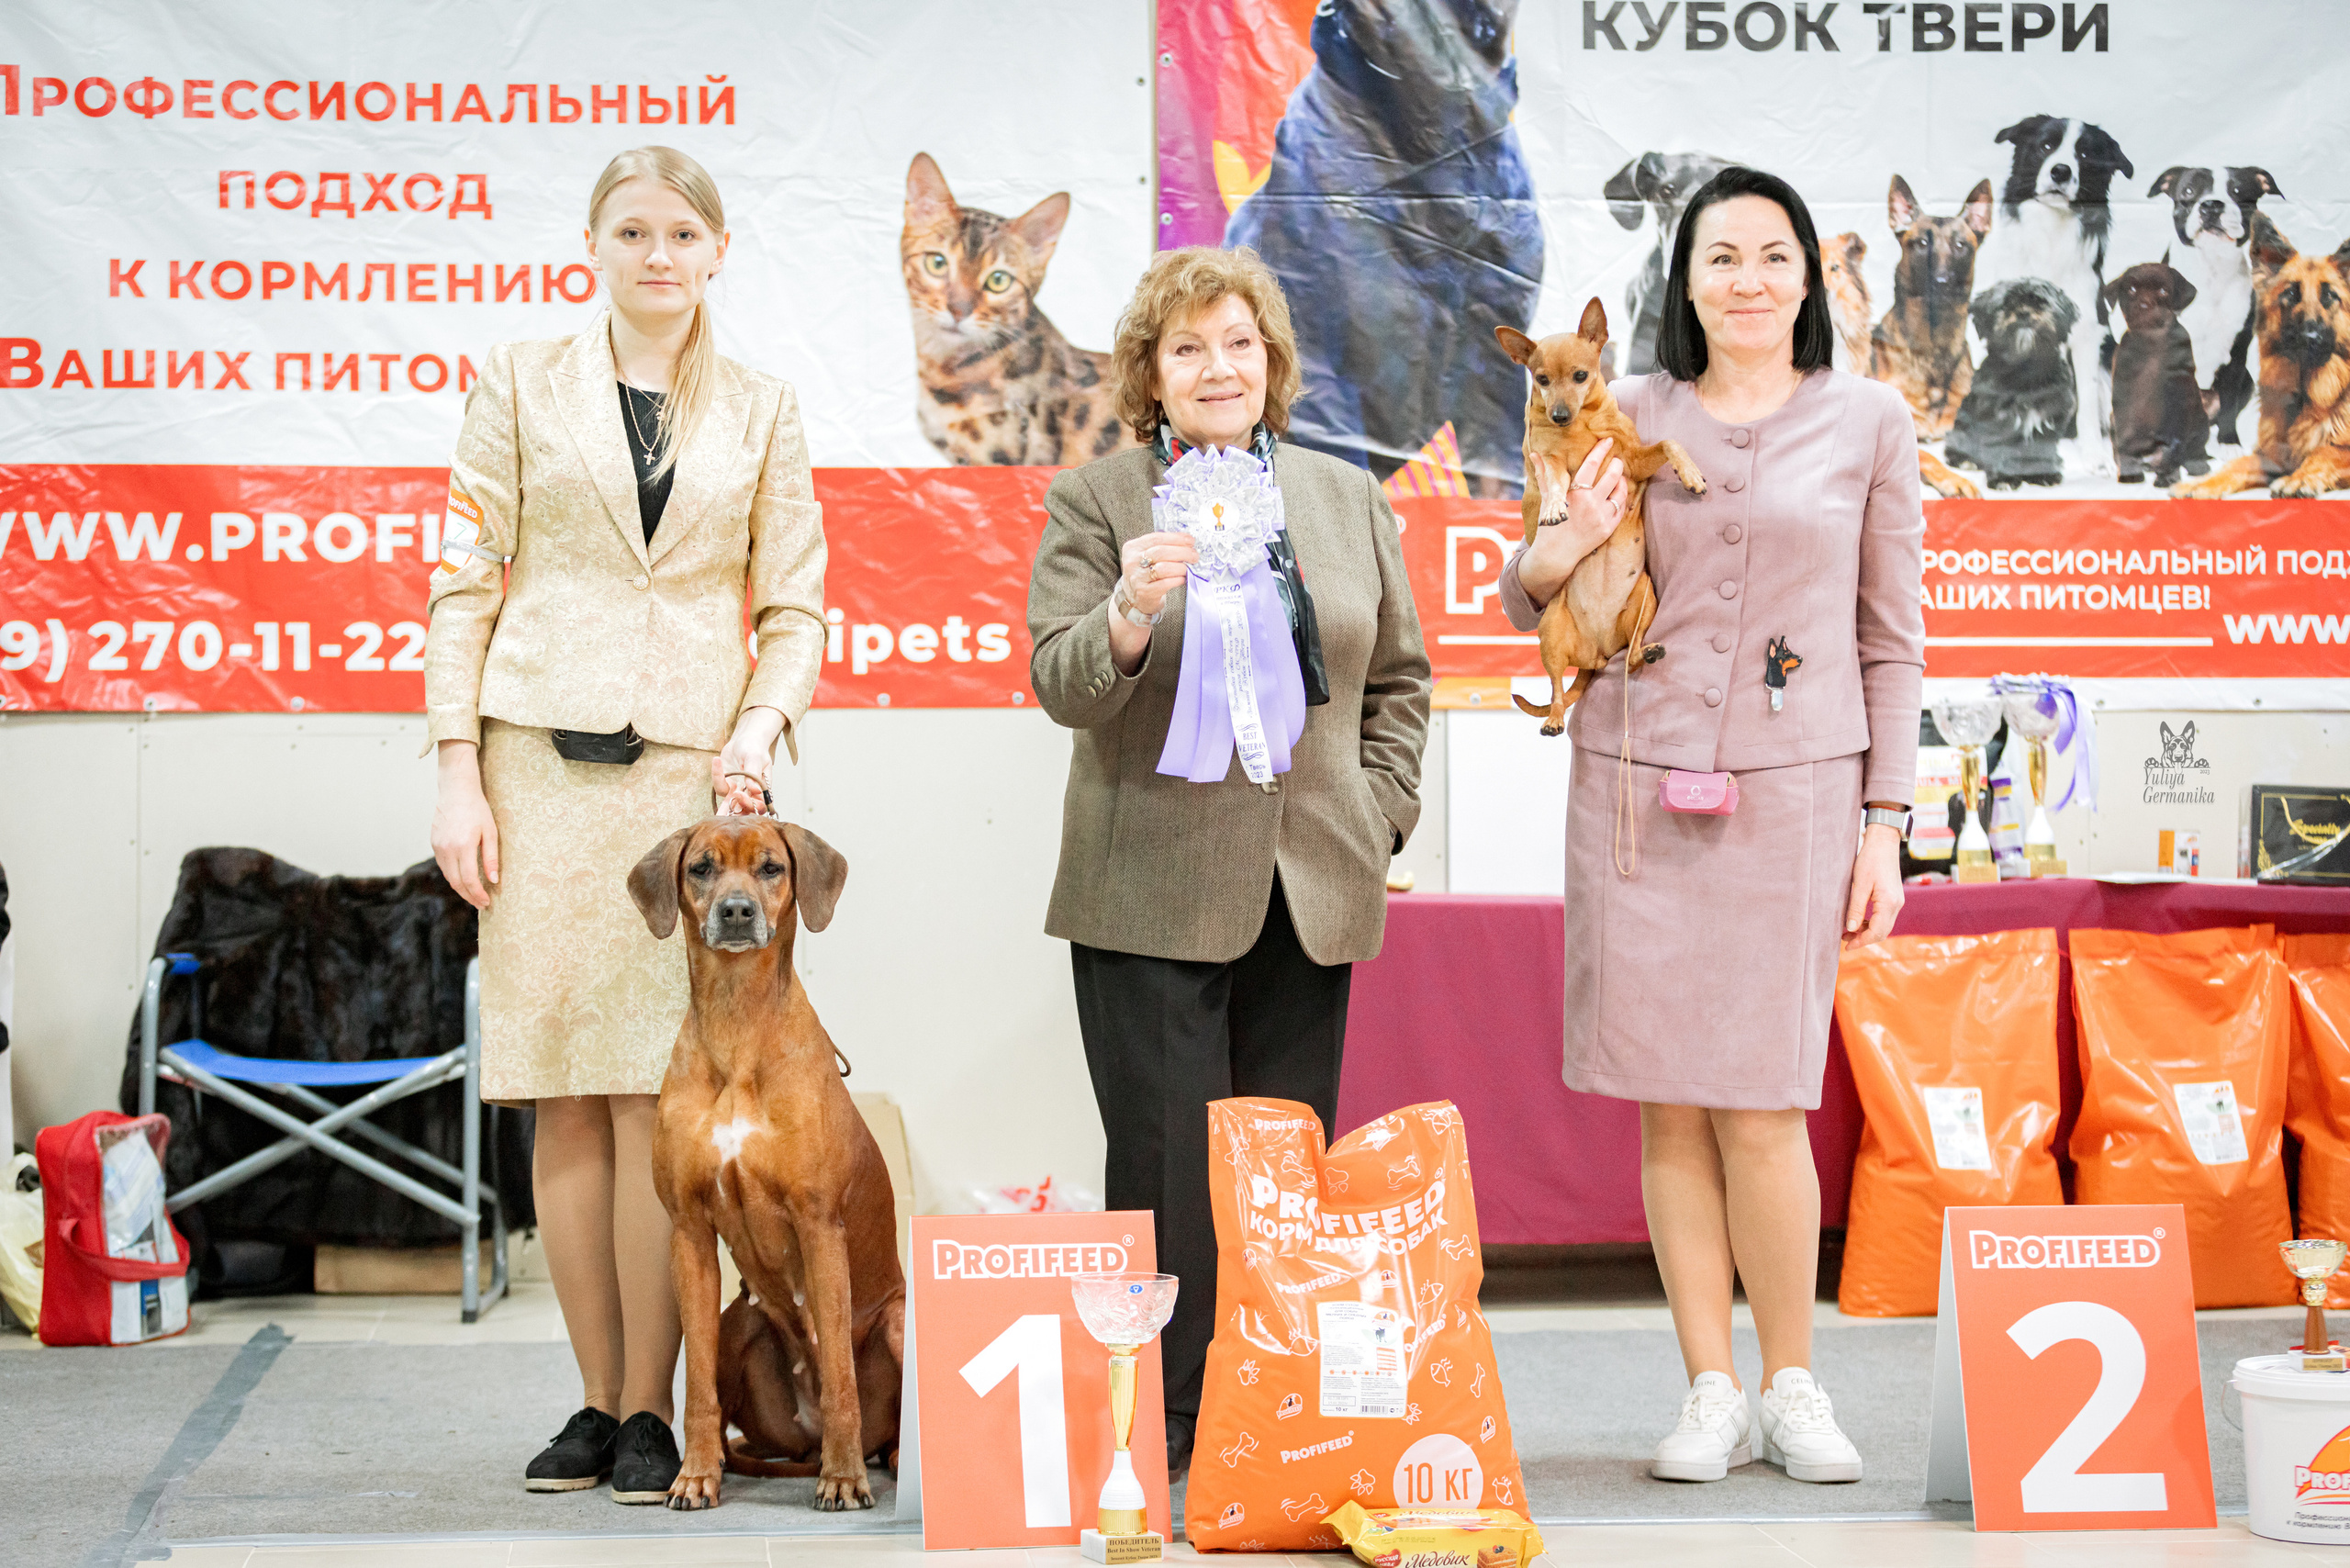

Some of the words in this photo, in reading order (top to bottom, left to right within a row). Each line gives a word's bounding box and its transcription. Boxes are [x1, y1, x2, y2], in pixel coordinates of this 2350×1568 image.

[1583, 2, 1840, 51] КУБОК
[1863, 3, 2109, 52] ТВЕРИ
[218, 171, 494, 220] ПОДХОД
[109, 258, 145, 297] К
[169, 261, 597, 304] КОРМЛЕНИЮ
[0, 337, 252, 390] ВАШИХ
[0, 512, 442, 563] WW.PROFI
[1921, 543, 2267, 576] РОФЕССИОНАЛЬНЫЙ
[2020, 585, 2211, 614] ПИТОМЦЕВ!
[87, 621, 426, 672] 270-11-22
[1242, 731, 1258, 741] BEST
[1249, 1213, 1313, 1246] КОРМ
[958, 1315, 1072, 1529] 1
[2006, 1301, 2168, 1513] 2
[1404, 1462, 1433, 1504] 10
[1109, 1538, 1159, 1546] ПОБЕДИТЕЛЬ
